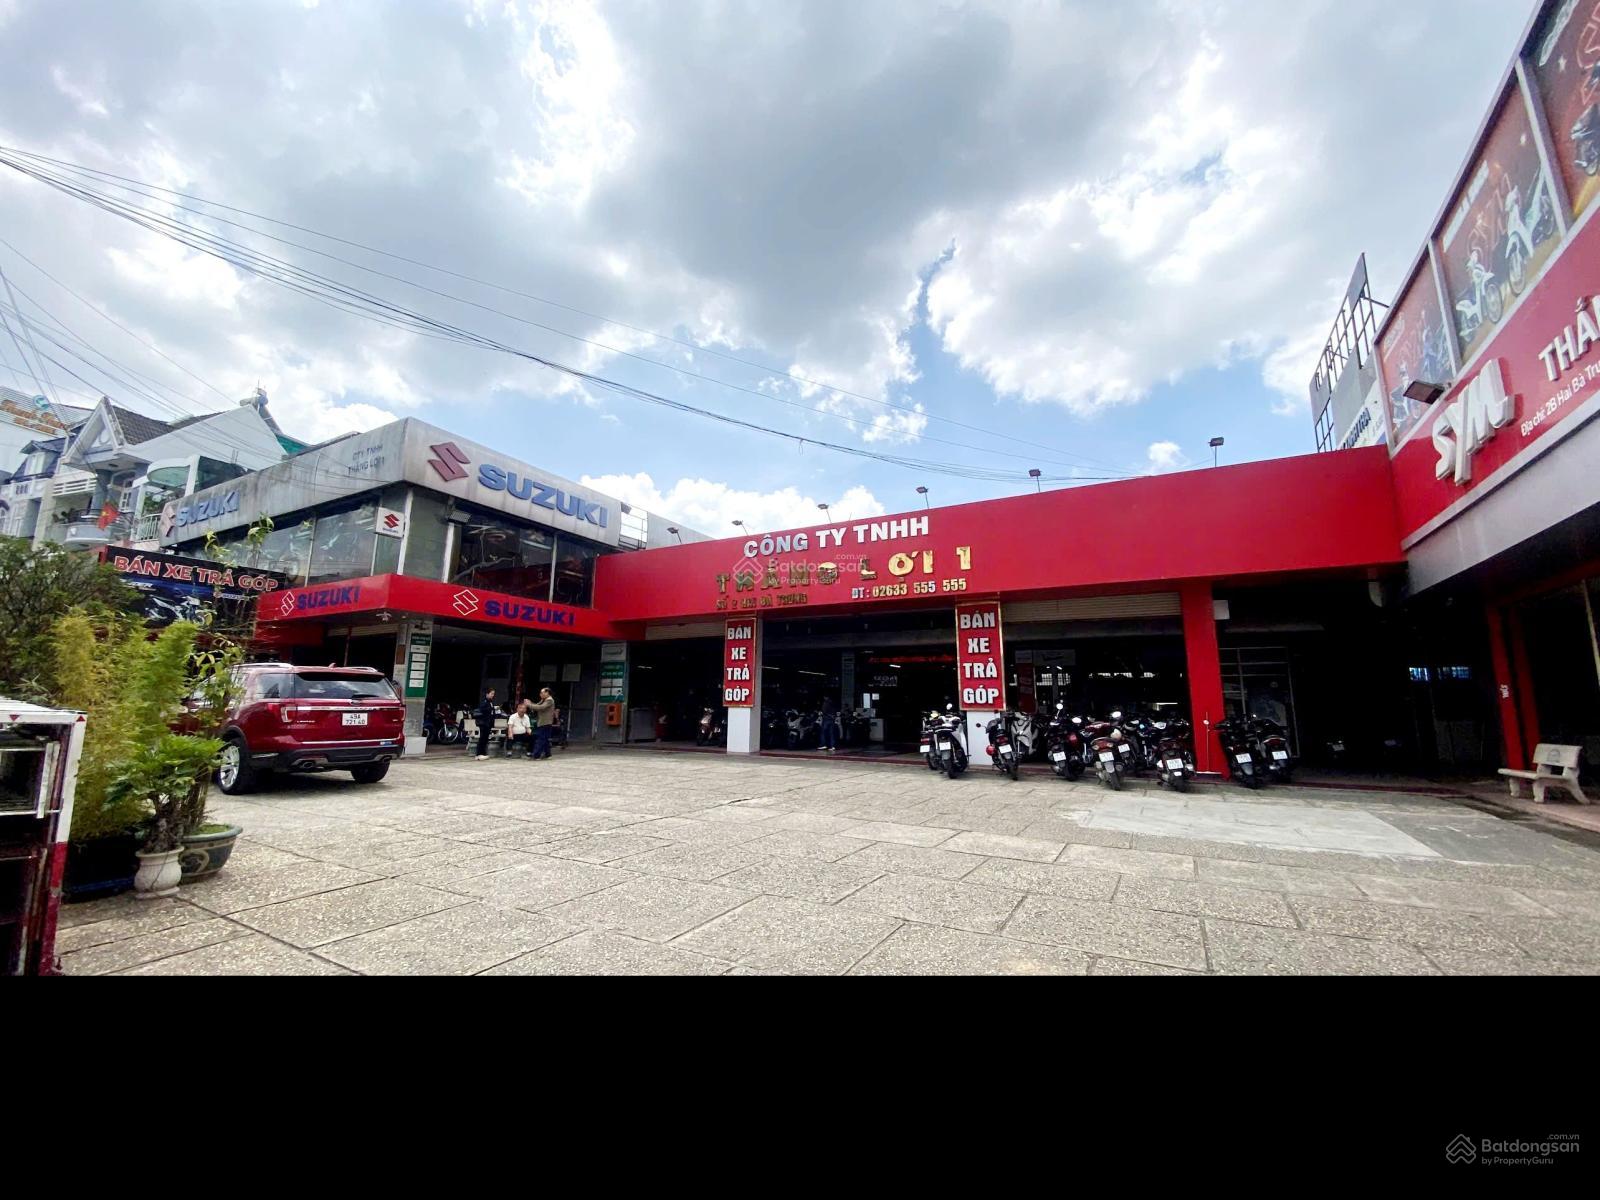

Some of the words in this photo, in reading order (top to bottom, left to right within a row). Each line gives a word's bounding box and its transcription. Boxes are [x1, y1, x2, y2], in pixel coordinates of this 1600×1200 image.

[1557, 383, 1573, 407] Hai
[1571, 373, 1587, 394] Bà
[1433, 358, 1514, 486] SYM
[478, 463, 608, 528] SUZUKI
[175, 491, 240, 527] SUZUKI
[743, 534, 809, 558] CÔNG
[815, 527, 848, 548] TY
[853, 516, 929, 543] TNHH
[956, 546, 973, 570] 1
[113, 555, 162, 577] BÁN
[163, 562, 193, 581] XE
[197, 567, 235, 587] TRẢ
[238, 573, 279, 592] GÓP
[296, 585, 360, 610] SUZUKI
[872, 583, 908, 598] 02633
[913, 582, 936, 594] 555
[942, 578, 967, 592] 555
[484, 600, 575, 626] SUZUKI
[960, 610, 999, 629] BÁN
[727, 625, 752, 640] BÁN
[731, 647, 747, 660] XE
[968, 637, 991, 653] XE
[726, 663, 750, 681] TRẢ
[962, 658, 998, 679] TRẢ
[725, 686, 750, 702] GÓP
[963, 685, 999, 705] GÓP
